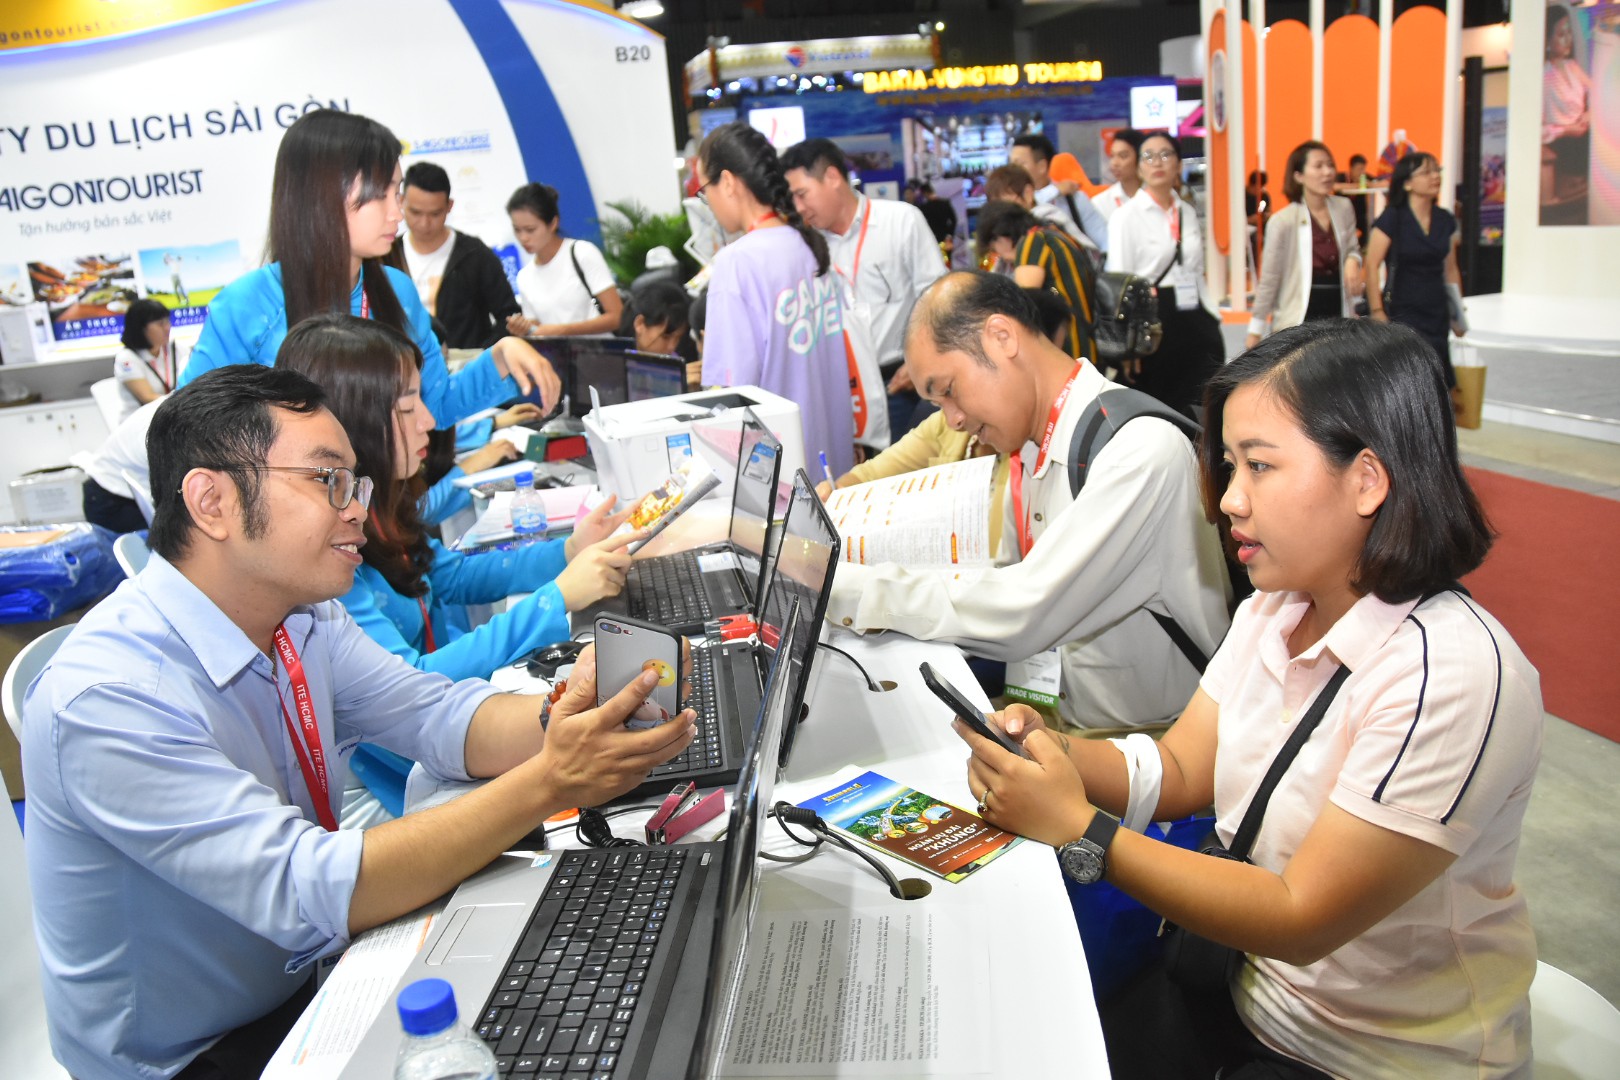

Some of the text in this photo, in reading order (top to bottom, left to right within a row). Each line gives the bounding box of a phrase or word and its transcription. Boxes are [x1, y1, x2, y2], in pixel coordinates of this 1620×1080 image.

[615, 45, 651, 63] B20
[44, 121, 96, 151] DU
[109, 113, 193, 150] LỊCH
[205, 101, 263, 136] SÀI
[277, 636, 295, 664] HCMC
[296, 684, 314, 730] ITE HCMC
[1006, 687, 1055, 705] TRADE VISITOR
[313, 749, 328, 793] ITE HCMC
[908, 836, 935, 852] NGÀN
